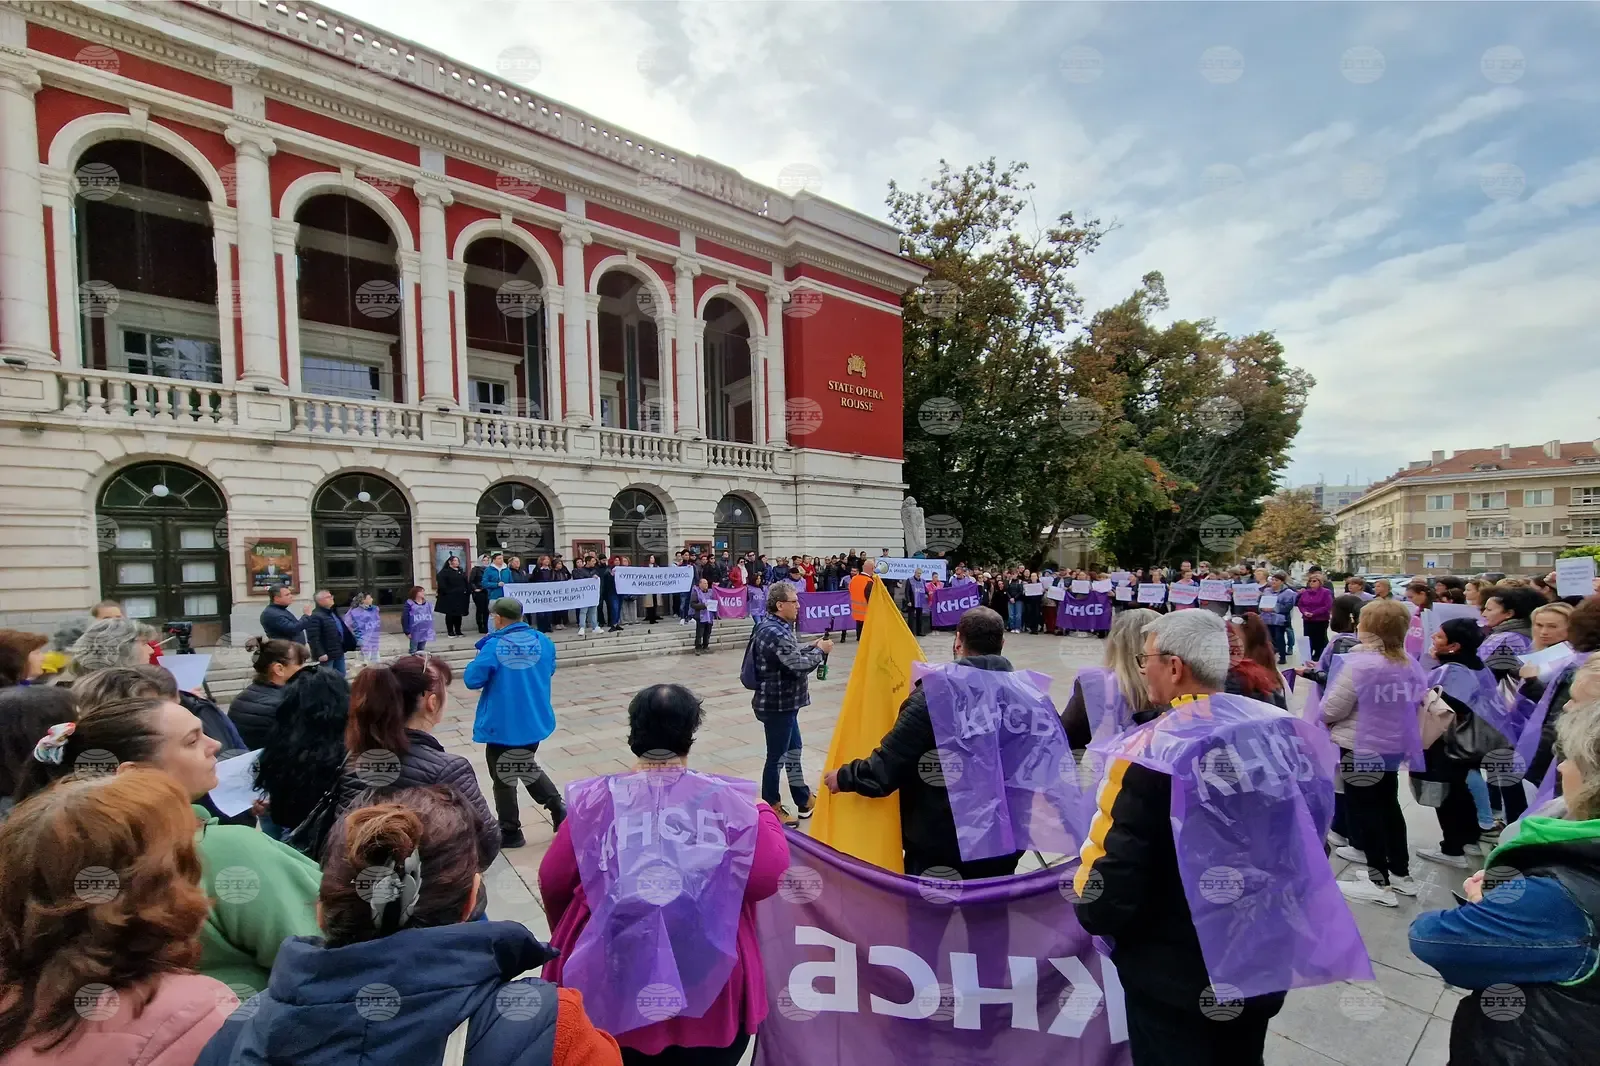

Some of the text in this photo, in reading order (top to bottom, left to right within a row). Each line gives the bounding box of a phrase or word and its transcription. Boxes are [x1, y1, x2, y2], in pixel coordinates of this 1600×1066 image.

[828, 380, 884, 400] STATE OPERA
[841, 397, 874, 412] ROUSSE
[509, 589, 551, 597] КУЛТУРАТА
[532, 594, 581, 604] ИНВЕСТИЦИЯ
[719, 596, 743, 607] КНСБ
[937, 595, 980, 614] КНСБ
[806, 604, 850, 619] КНСБ
[1065, 603, 1104, 616] КНСБ
